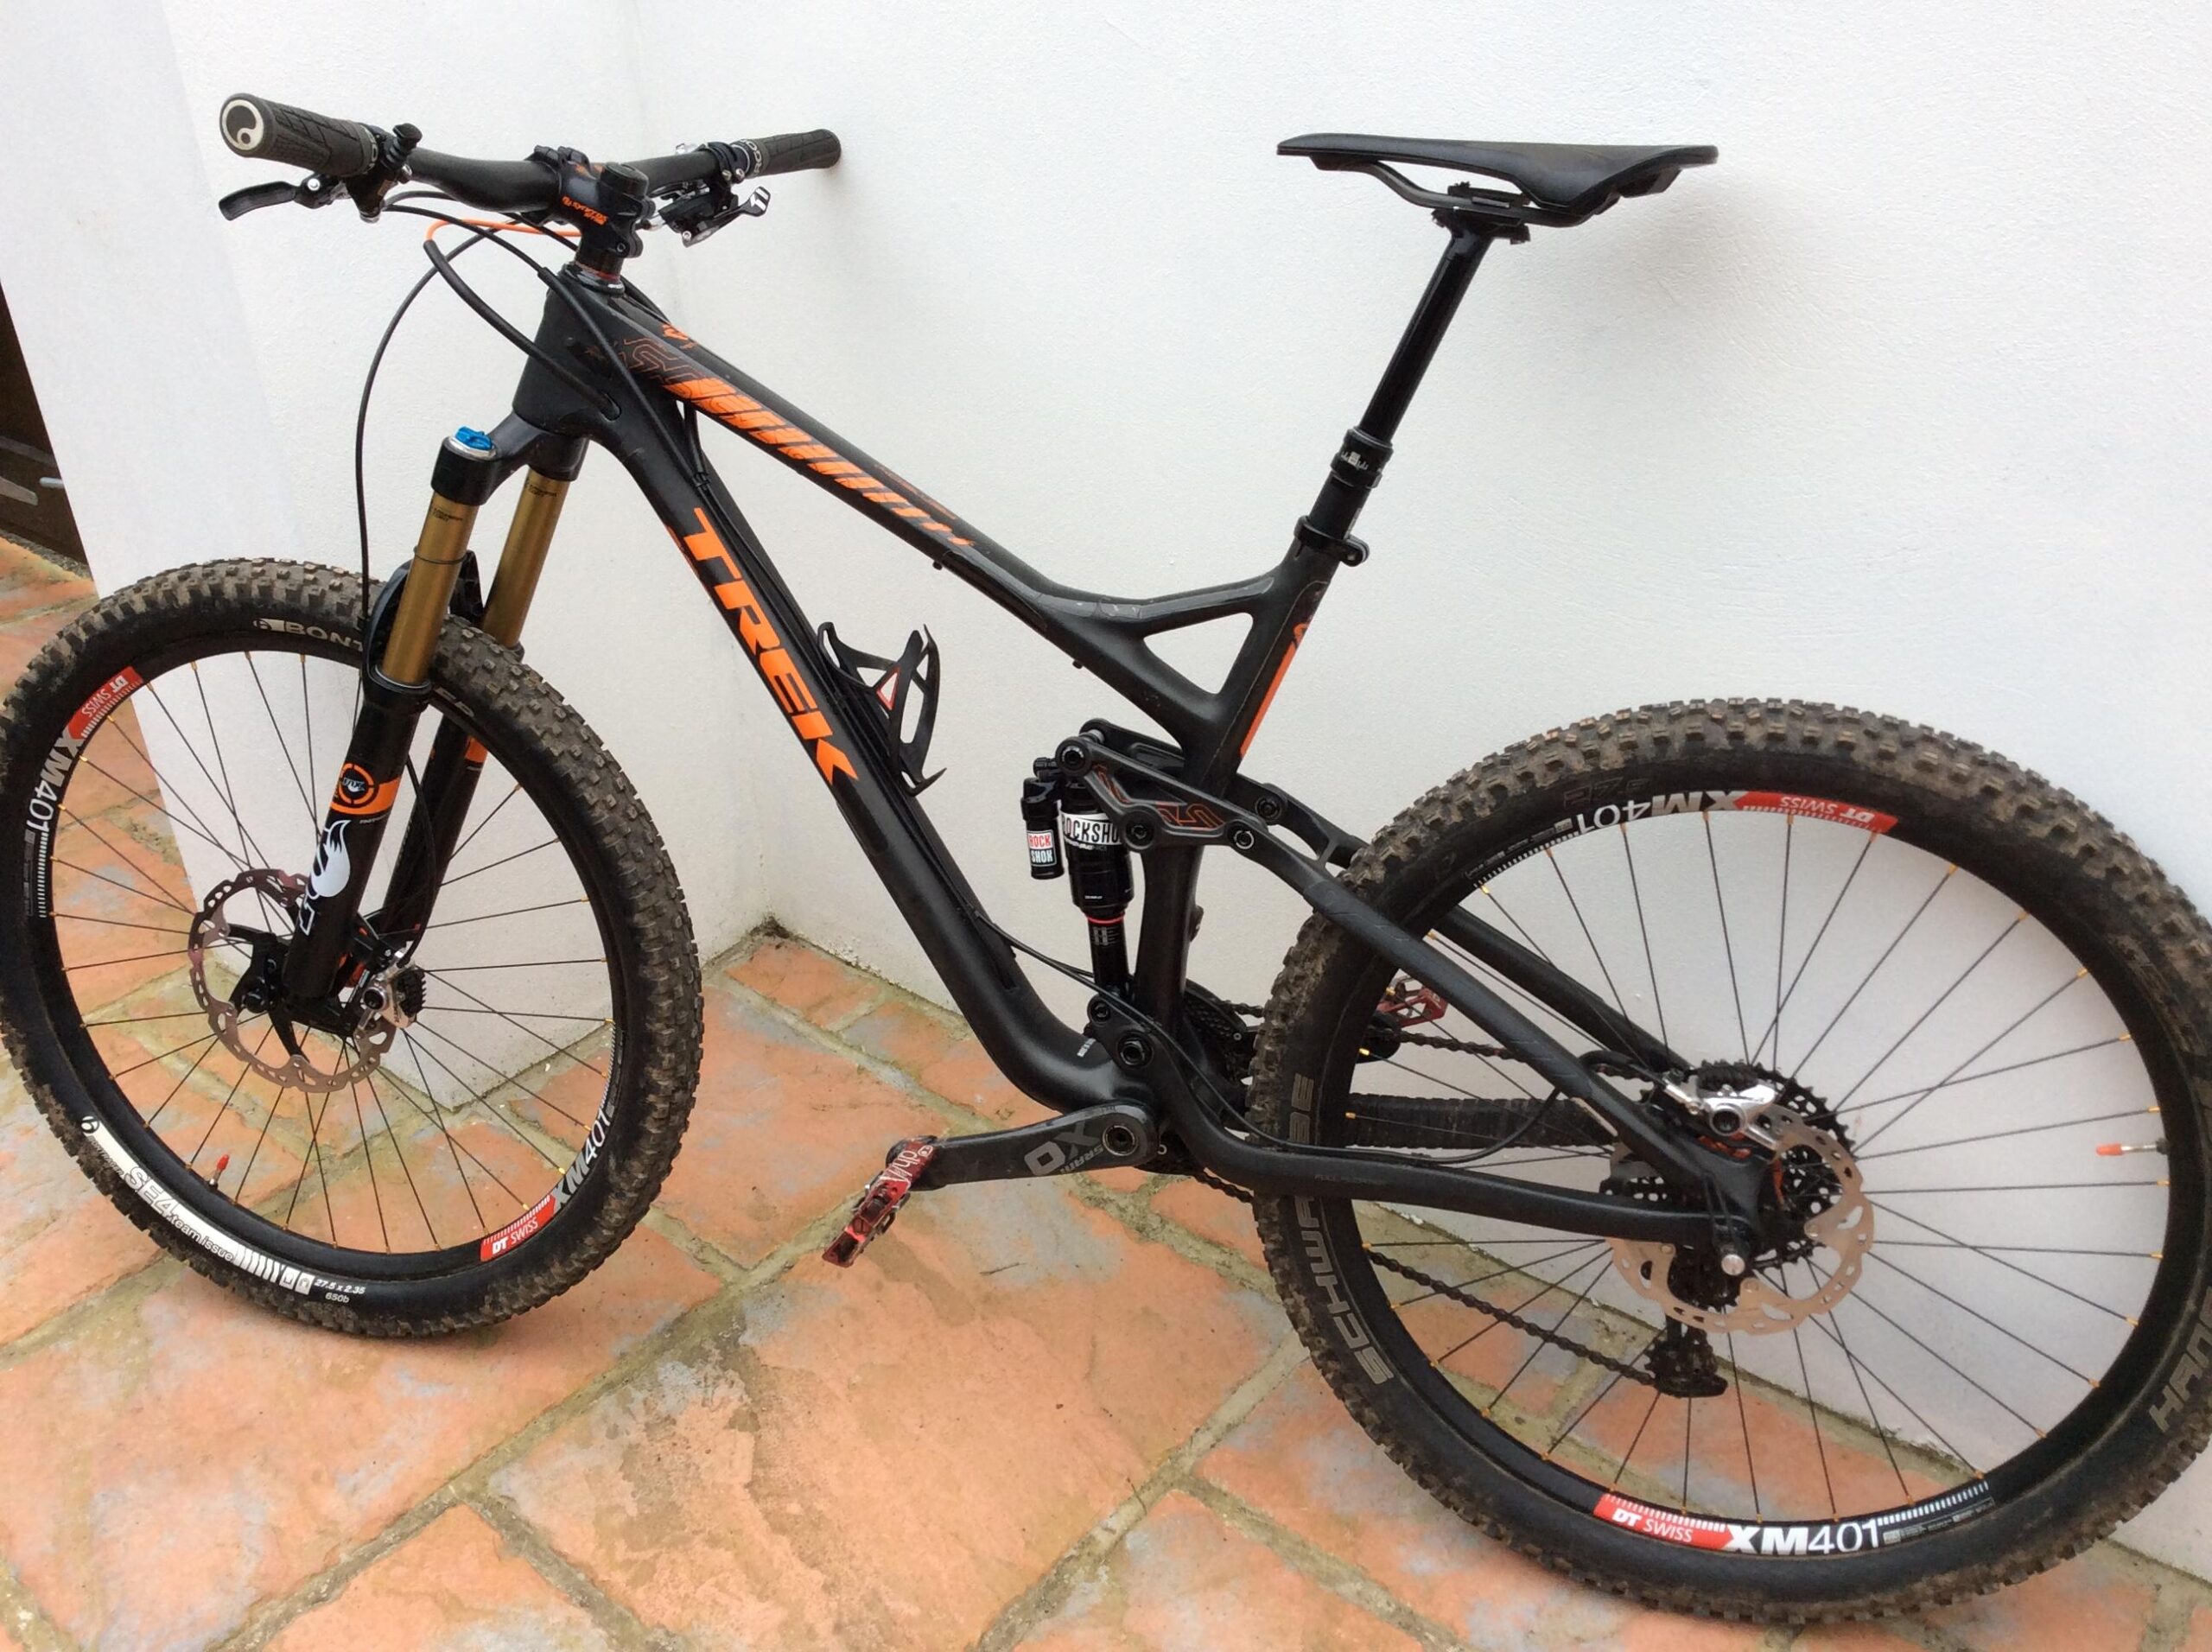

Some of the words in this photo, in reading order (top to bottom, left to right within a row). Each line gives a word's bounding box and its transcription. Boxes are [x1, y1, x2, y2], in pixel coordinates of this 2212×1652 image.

[683, 508, 858, 785] TREK
[110, 675, 127, 693] DT
[81, 689, 111, 718] SWISS
[26, 726, 85, 832] XM401
[1577, 790, 1749, 835] XM401
[1780, 796, 1838, 815] SWISS
[1840, 807, 1875, 823] DT
[1028, 834, 1052, 848] ROCK
[553, 1107, 611, 1215] XM401
[170, 1214, 202, 1244] team
[200, 1235, 235, 1262] issue
[492, 1236, 508, 1255] DT
[511, 1218, 539, 1245] SWISS
[1289, 1073, 1394, 1384] SCHWABE
[1611, 1508, 1642, 1527] DT
[1643, 1518, 1694, 1542] SWISS
[1726, 1518, 1879, 1555] XM401
